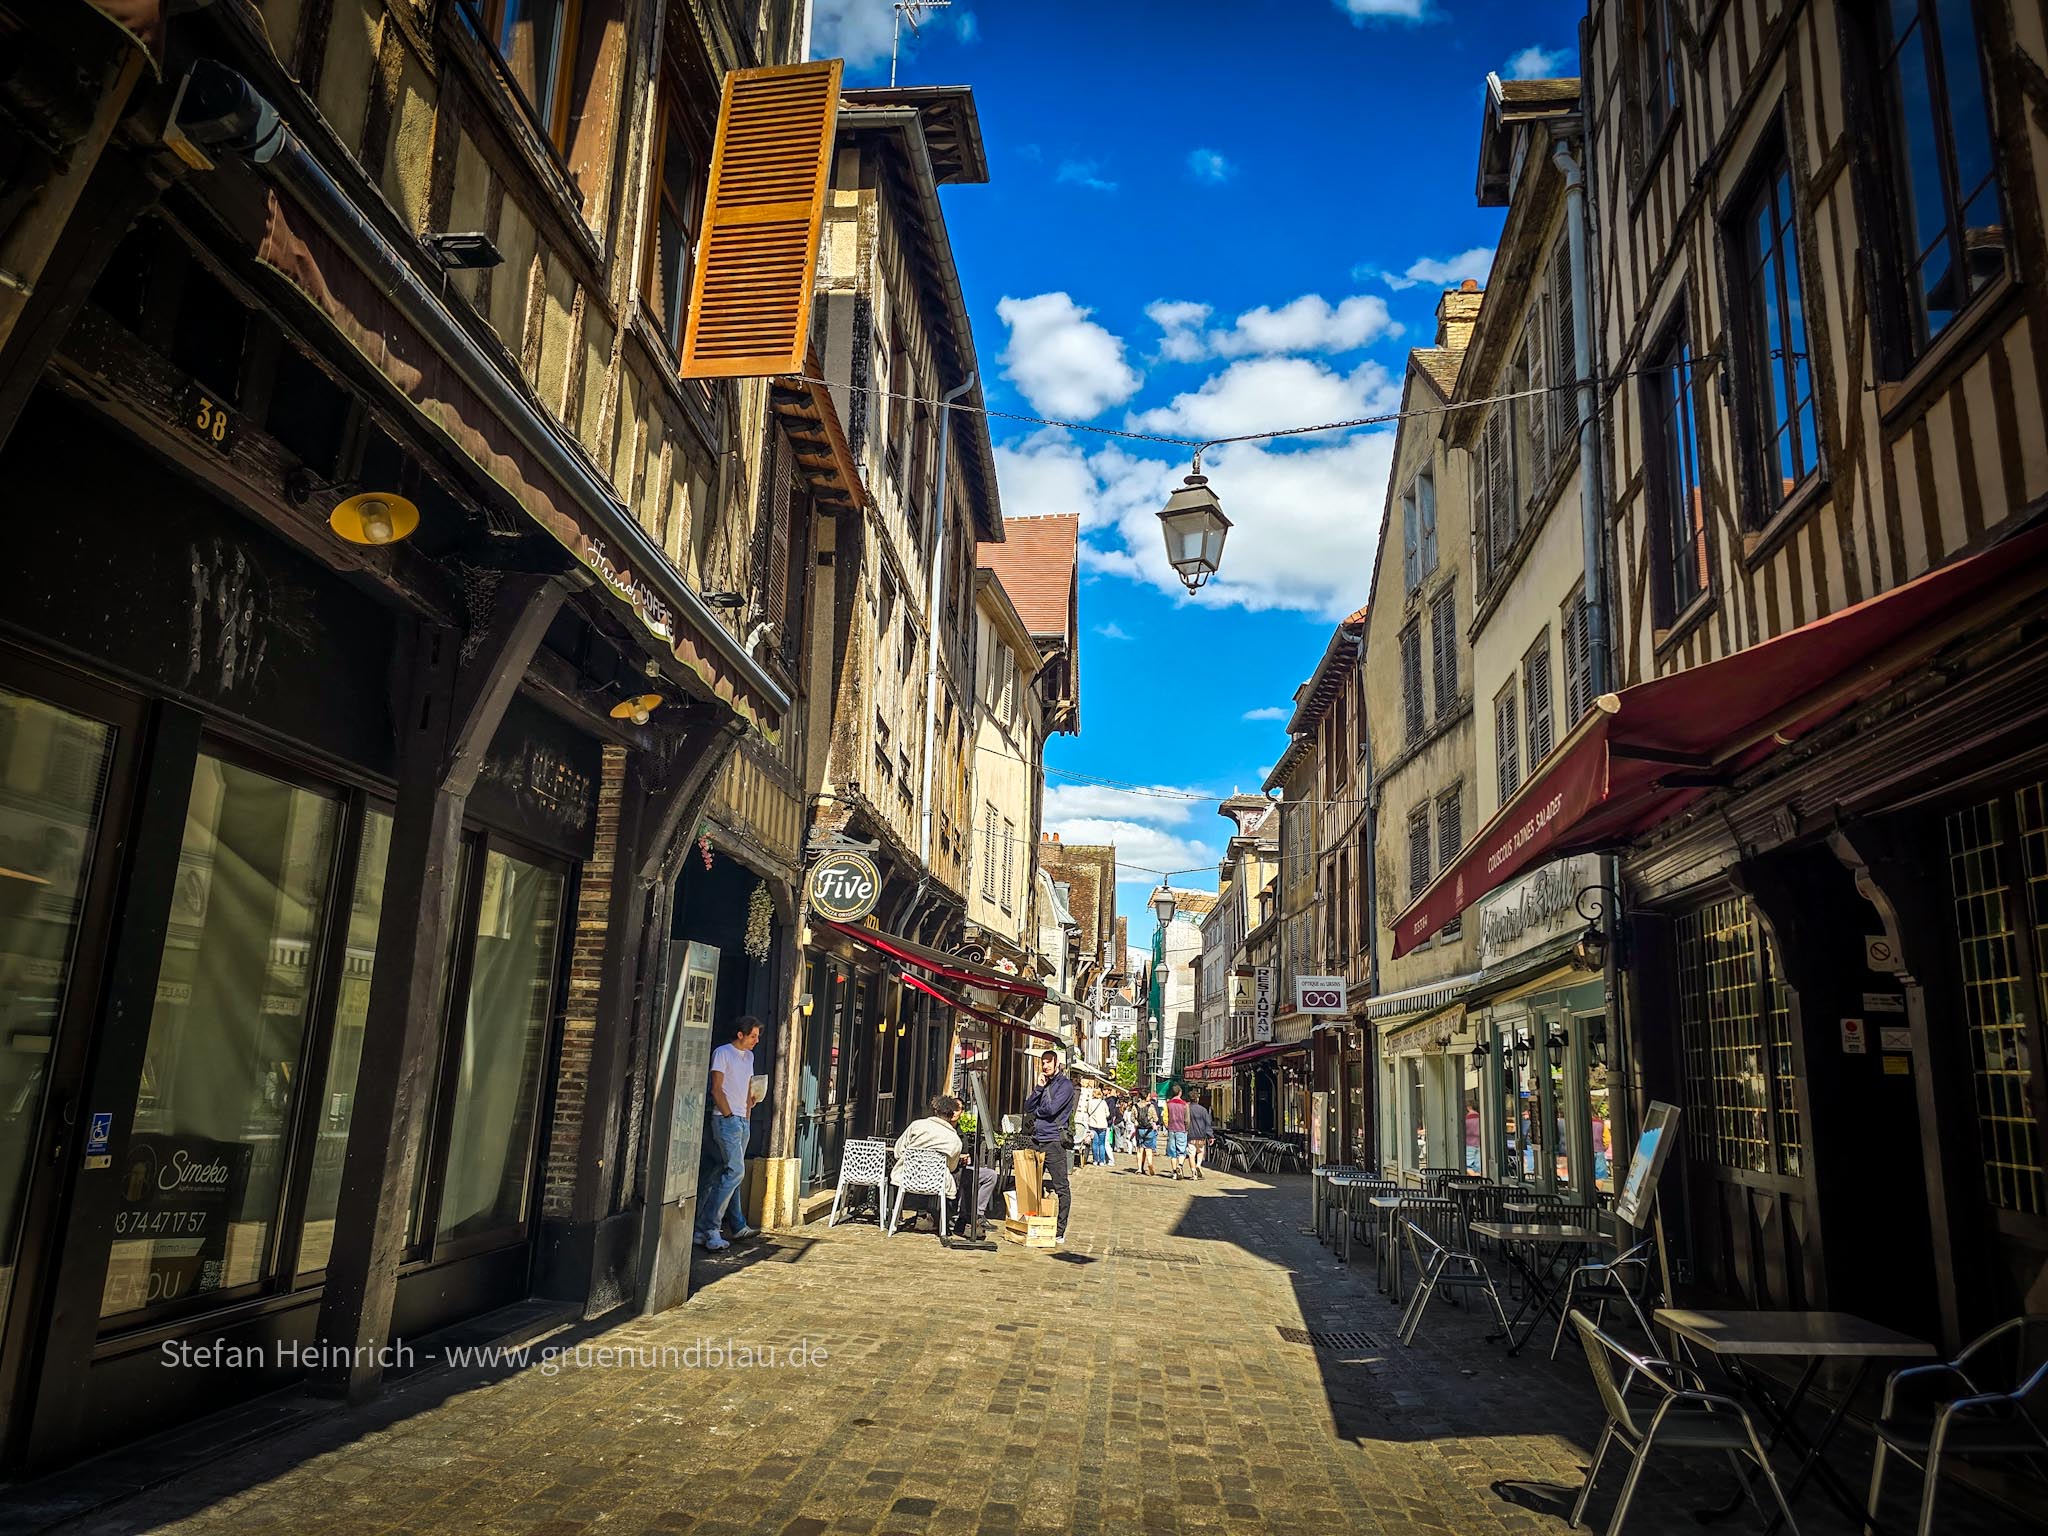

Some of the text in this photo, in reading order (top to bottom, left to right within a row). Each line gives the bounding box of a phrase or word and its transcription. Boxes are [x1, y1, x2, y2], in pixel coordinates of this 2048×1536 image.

[197, 397, 228, 442] 38
[1488, 793, 1563, 874] COUSCOUS TAJINES SALADES
[814, 868, 873, 899] Five
[158, 1149, 229, 1191] Simeka
[129, 1212, 150, 1233] 74
[150, 1212, 171, 1233] 47
[173, 1212, 187, 1233] 17
[187, 1212, 207, 1232] 57
